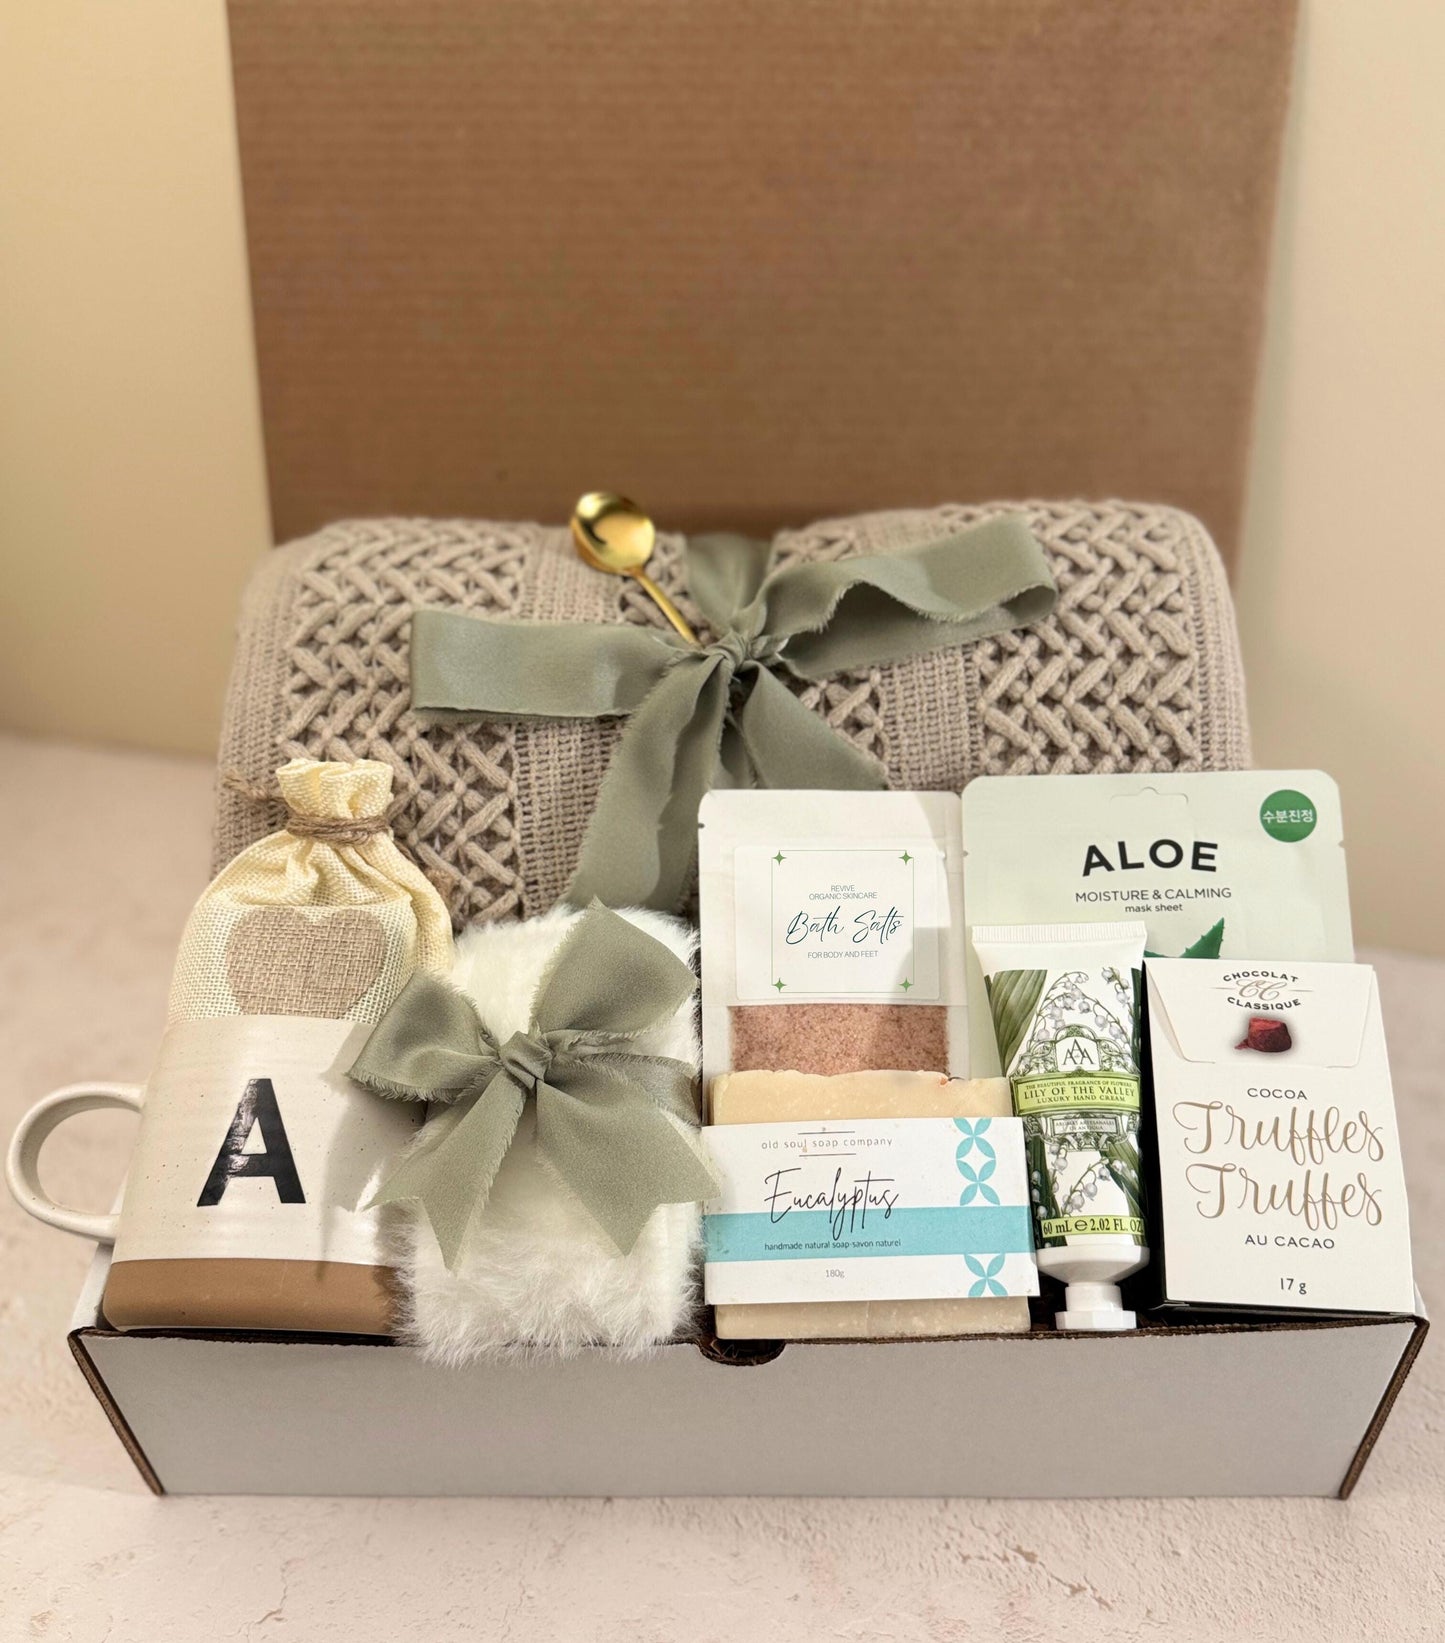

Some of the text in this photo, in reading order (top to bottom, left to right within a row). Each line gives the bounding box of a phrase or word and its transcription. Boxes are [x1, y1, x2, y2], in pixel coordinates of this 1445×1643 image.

[1262, 809, 1313, 824] 수분진정
[1082, 838, 1219, 877] ALOE
[830, 884, 856, 892] REVIVE
[1075, 887, 1232, 902] MOISTURE & CALMING
[842, 892, 878, 900] SKINCARE
[1124, 903, 1183, 913] mask sheet
[785, 905, 905, 945] Bath Salts
[807, 951, 822, 959] FOR
[823, 951, 843, 959] BODY
[860, 950, 879, 958] FEET
[1223, 970, 1299, 983] CHOCOLAT
[1227, 996, 1301, 1011] CLASSIQUE
[1024, 1085, 1135, 1100] LILY OF THE VALLEY
[1037, 1095, 1070, 1104] LUXURY
[1247, 1087, 1308, 1100] COCOA
[1172, 1100, 1384, 1166] Truffles
[196, 1078, 307, 1207] A
[761, 1137, 893, 1150] old soul soap company
[763, 1167, 899, 1241] Eucalyptus
[1185, 1163, 1382, 1232] Truffes
[1043, 1222, 1053, 1235] 60
[1055, 1219, 1073, 1232] mL
[1090, 1218, 1110, 1231] 2.02
[1113, 1218, 1128, 1231] FL.
[764, 1242, 803, 1251] handmade
[804, 1240, 831, 1250] natural
[1245, 1234, 1335, 1249] AU CACAO
[825, 1268, 846, 1279] 180g
[1280, 1278, 1307, 1295] 17 g
